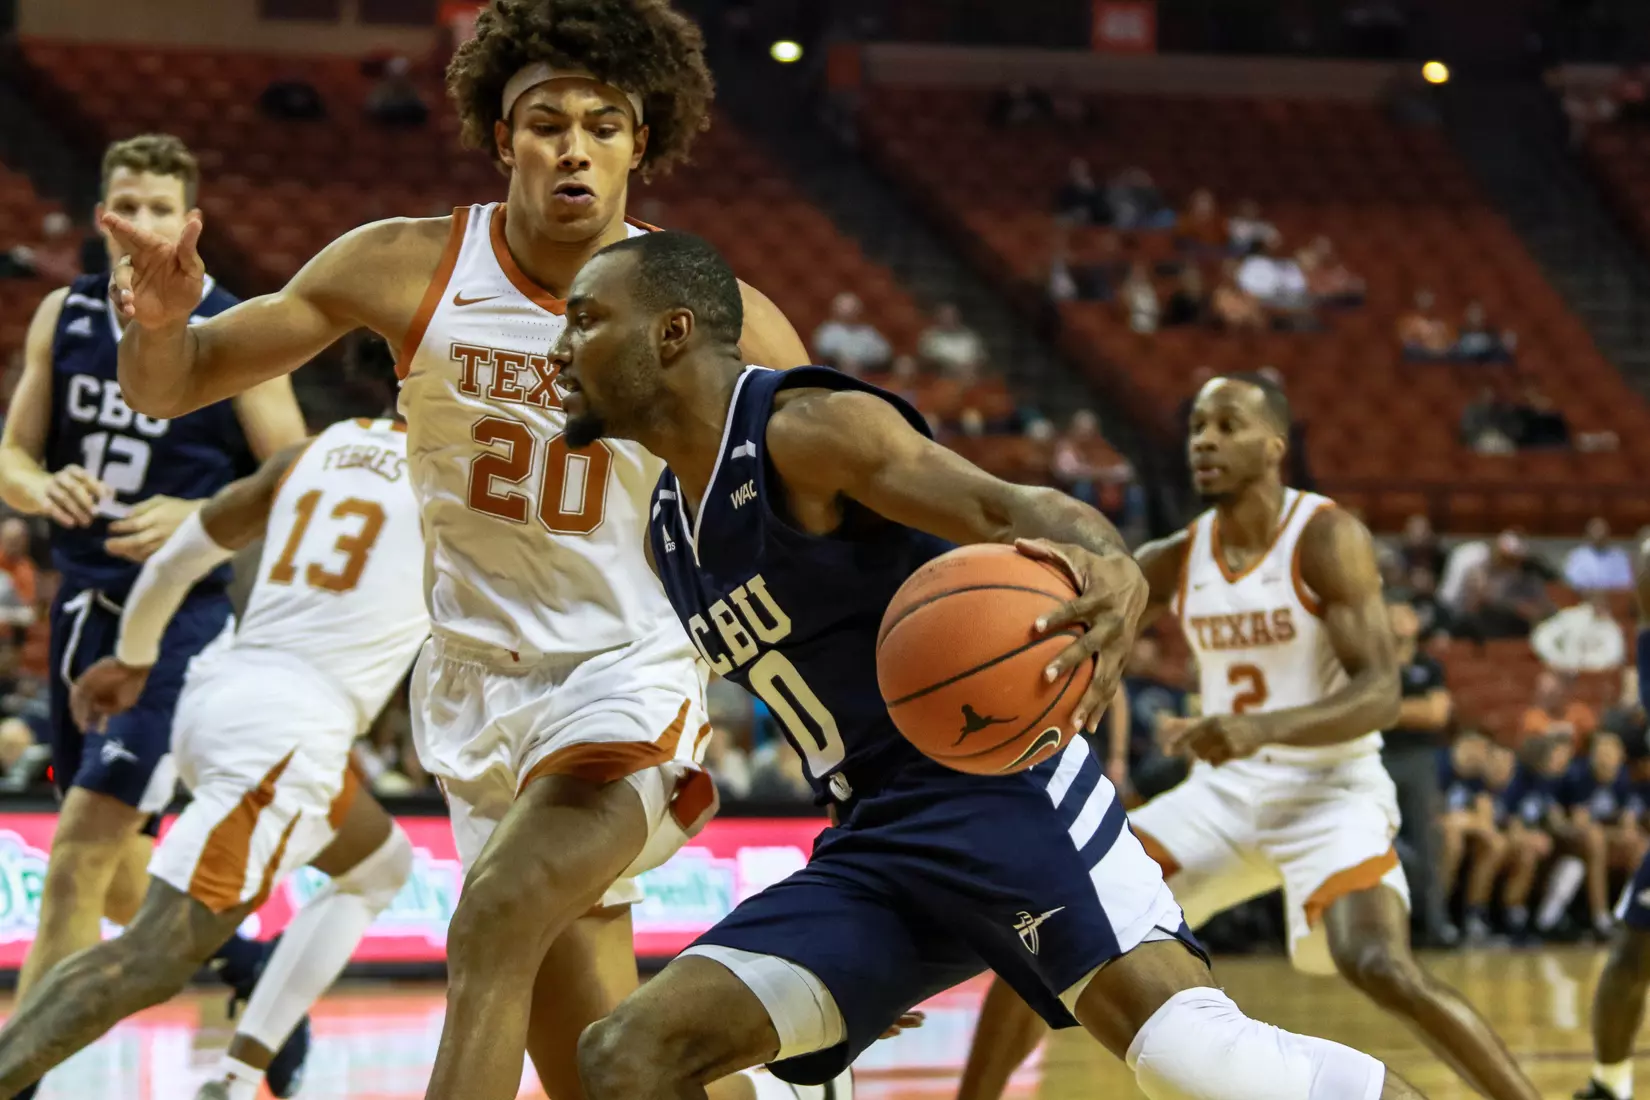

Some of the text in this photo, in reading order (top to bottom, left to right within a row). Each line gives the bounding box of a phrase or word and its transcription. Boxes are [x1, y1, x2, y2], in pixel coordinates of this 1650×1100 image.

[450, 342, 564, 413] TEX
[81, 431, 152, 518] 12
[468, 415, 614, 536] 20
[730, 479, 758, 510] WAC
[267, 488, 388, 597] 13
[688, 573, 792, 677] CBU
[1189, 606, 1297, 652] TEXAS
[748, 649, 846, 779] 0
[1227, 662, 1270, 716] 2
